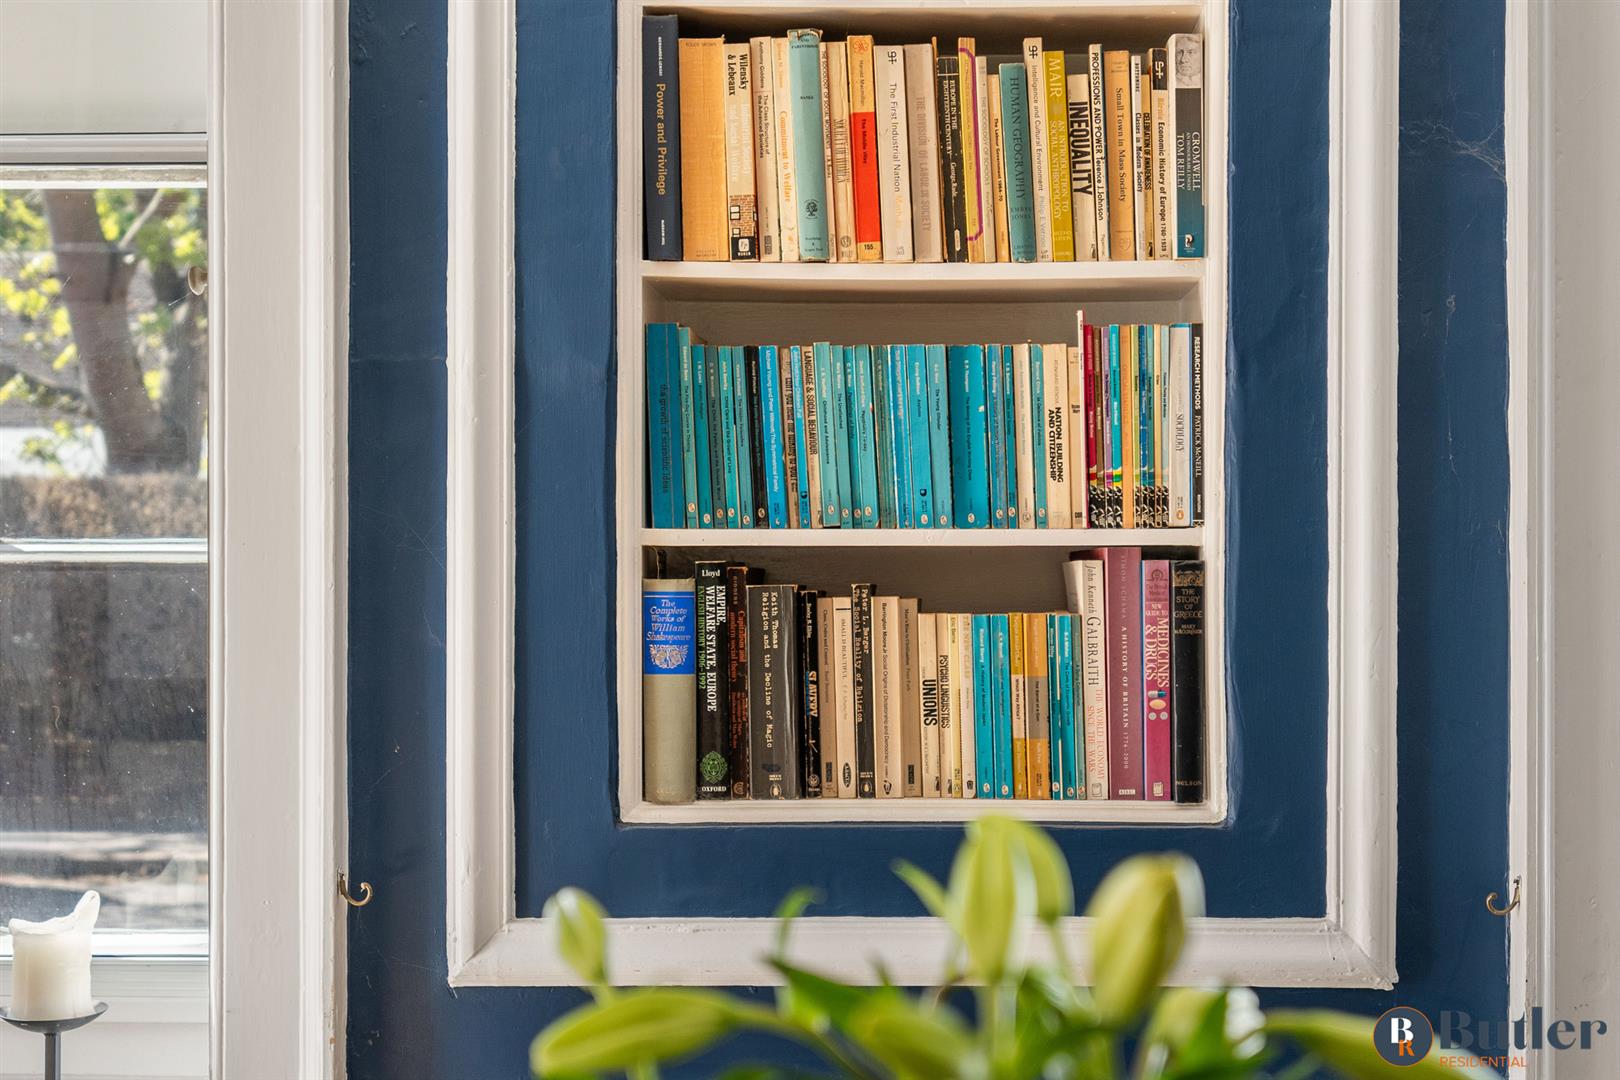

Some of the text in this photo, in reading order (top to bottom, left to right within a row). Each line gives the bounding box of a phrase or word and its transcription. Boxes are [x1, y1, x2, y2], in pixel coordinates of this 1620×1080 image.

[728, 62, 737, 96] Lebeaux
[738, 54, 749, 90] Wilensky
[889, 83, 898, 99] The
[1031, 65, 1040, 104] Intelligence
[1048, 58, 1063, 97] MAIR
[1091, 52, 1100, 106] PROFESSIONS
[890, 101, 899, 120] First
[949, 80, 957, 105] EUROPE
[951, 107, 957, 115] IN
[1009, 78, 1020, 124] HUMAN
[656, 83, 667, 195] Power and Privilege
[891, 122, 901, 162] Industrial
[1034, 120, 1042, 147] Cultural
[1068, 102, 1093, 196] INEQUALITY
[1095, 126, 1103, 155] POWER
[1116, 88, 1127, 203] Small Town in Mass Society
[1143, 112, 1152, 191] CELEBRATION OF AWARENESS
[1158, 122, 1167, 157] Economic
[780, 110, 792, 203] Commitment to Welfare
[916, 97, 931, 231] THE DIVISION OF LABOR IN SOCIETY
[1012, 128, 1025, 200] GEOGRAPHY
[1036, 148, 1044, 191] Environment
[1049, 120, 1062, 220] SOCIAL ANTHROPOLOGY
[1058, 120, 1069, 212] AN INTRODUCTION TO
[1095, 157, 1105, 184] Terence
[1158, 158, 1167, 185] History
[1177, 133, 1186, 190] TOM REILLY
[1192, 131, 1201, 192] CROMWELL
[893, 164, 902, 192] Nation
[1160, 187, 1167, 195] of
[1158, 196, 1168, 222] Europe
[804, 351, 814, 386] LANGUAGE
[807, 395, 816, 419] SOCIAL
[808, 419, 818, 455] BEHAVIOUR
[1175, 413, 1185, 452] SOCIOLOGY
[1049, 430, 1057, 482] CITIZENSHIP
[1056, 443, 1064, 483] BUILDING
[702, 570, 720, 578] Lloyd
[650, 607, 687, 616] Complete
[715, 585, 726, 626] EMPIRE,
[761, 592, 770, 631] Religion
[854, 607, 862, 634] Social
[862, 616, 869, 625] L.
[651, 623, 685, 631] William
[771, 620, 779, 649] Thomas
[862, 627, 870, 654] Berger
[1085, 566, 1102, 686] John Kenneth GALBRAITH
[706, 586, 717, 712] WELFARE STATE, EUROPE
[854, 638, 862, 669] Reality
[1145, 624, 1157, 681] & DRUGS
[1158, 617, 1169, 689] MEDICINES
[698, 650, 706, 690] 1906-1992
[856, 673, 863, 682] of
[1122, 676, 1128, 688] OF
[764, 673, 772, 706] Decline
[806, 671, 818, 718] SLAVERY
[856, 686, 864, 723] Religion
[922, 679, 937, 726] UNIONS
[766, 711, 773, 720] of
[765, 724, 773, 749] Magic
[1088, 705, 1097, 773] SINCE THE WARS
[1096, 689, 1105, 781] THE WORLD ECONOMY
